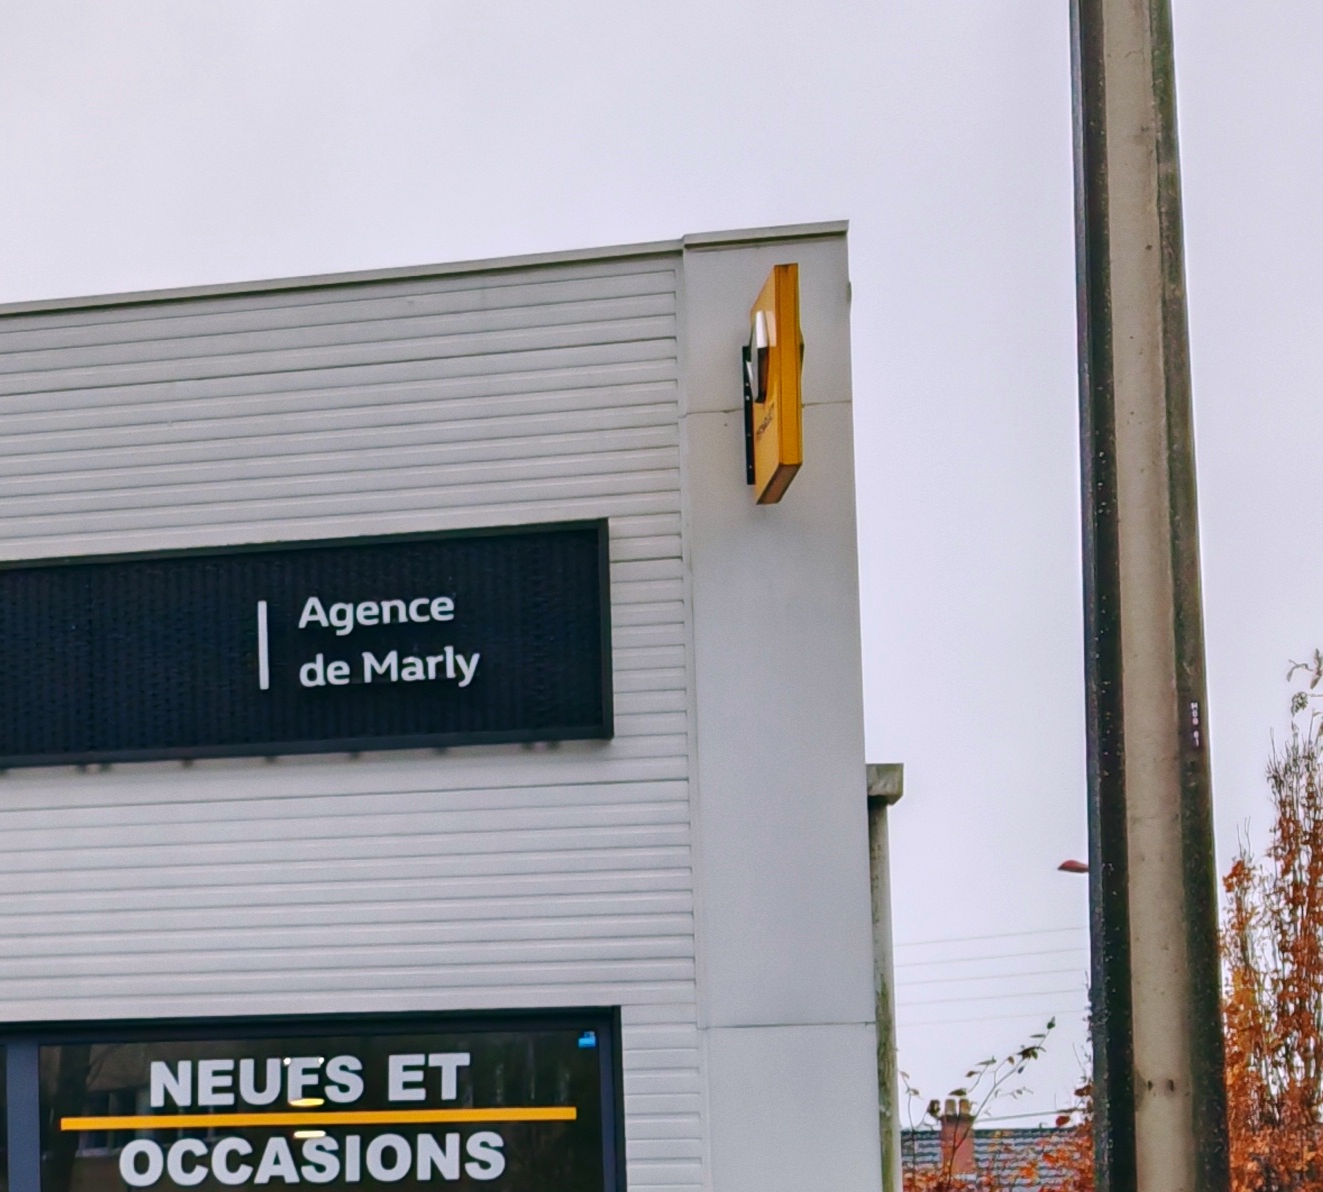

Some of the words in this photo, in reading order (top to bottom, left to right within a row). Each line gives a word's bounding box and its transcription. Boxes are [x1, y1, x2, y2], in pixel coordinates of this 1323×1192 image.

[298, 596, 455, 637] Agence
[299, 653, 350, 687] de
[361, 645, 481, 688] Marly
[150, 1055, 364, 1108] NEUFS
[388, 1052, 471, 1102] ET
[119, 1131, 506, 1188] OCCASIONS
